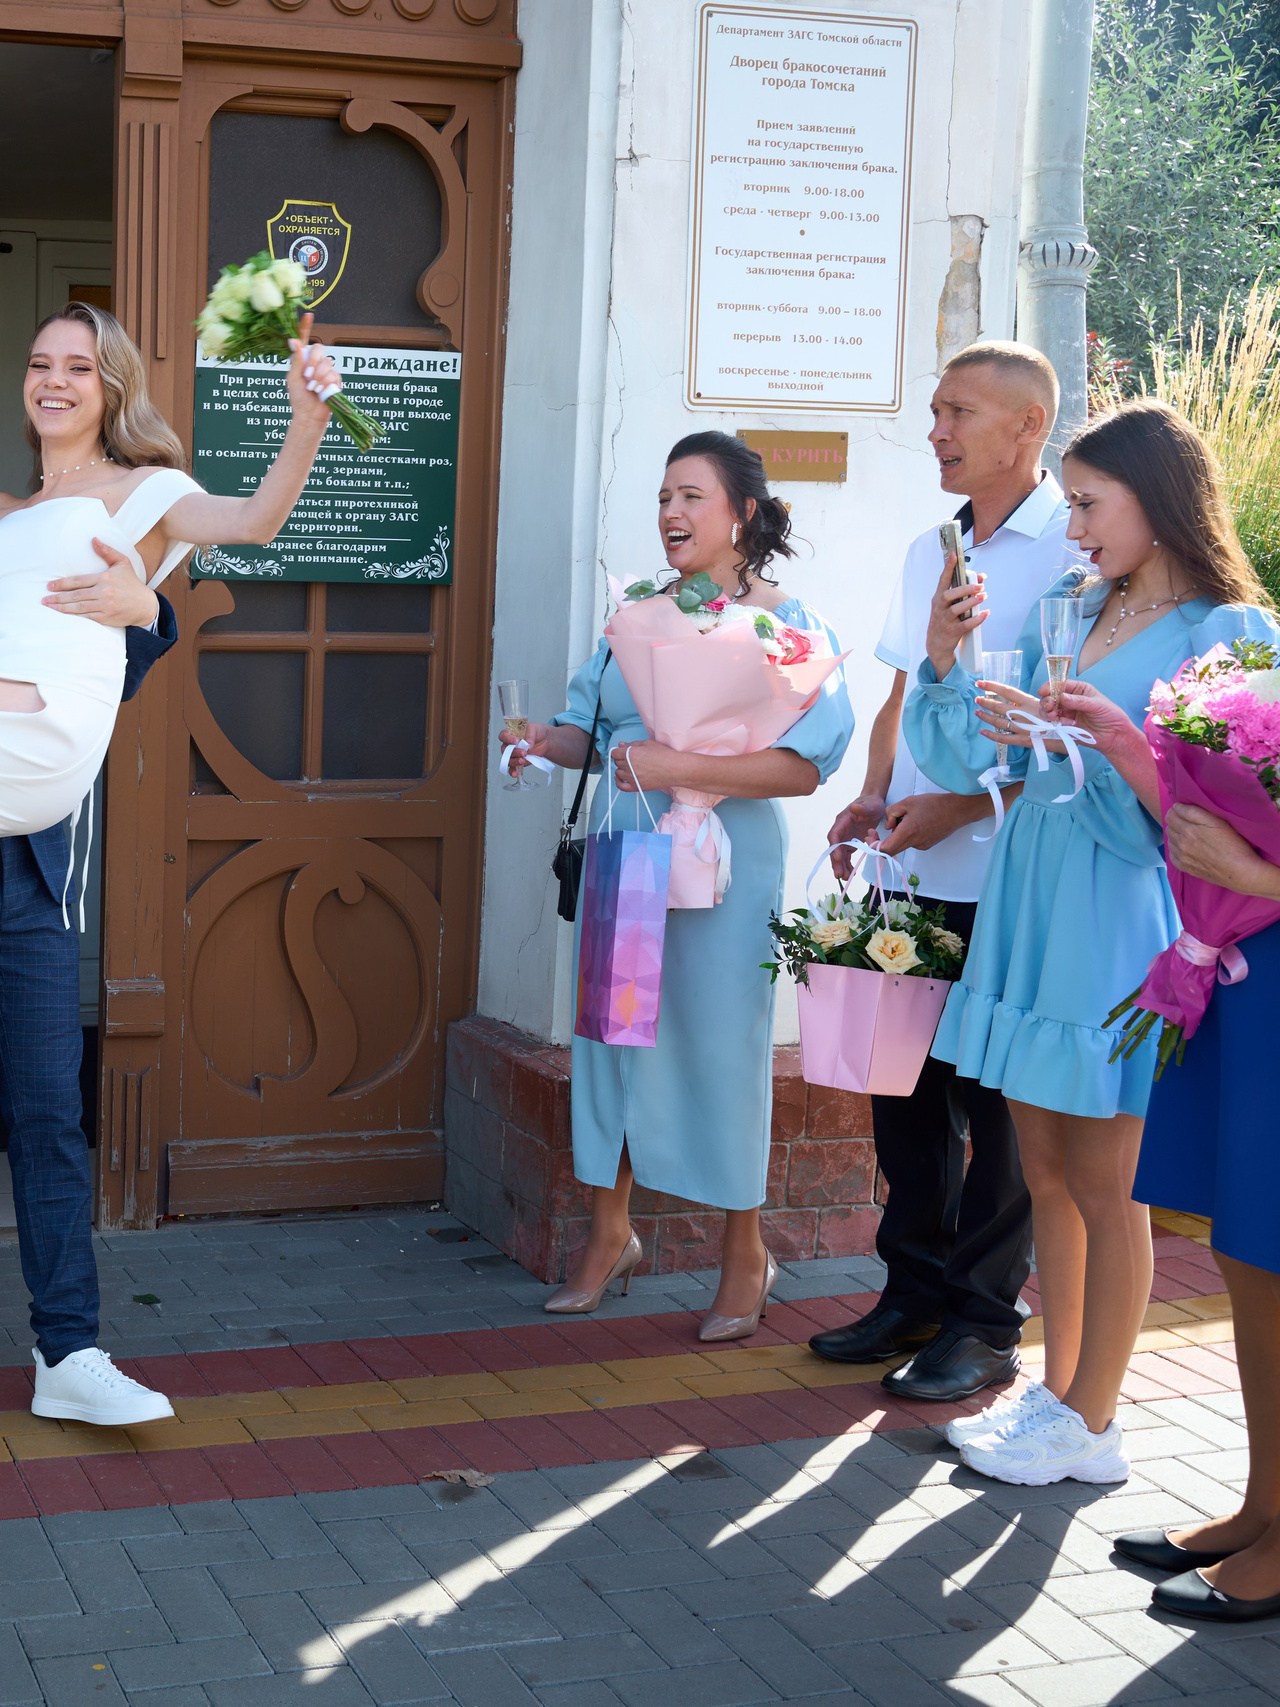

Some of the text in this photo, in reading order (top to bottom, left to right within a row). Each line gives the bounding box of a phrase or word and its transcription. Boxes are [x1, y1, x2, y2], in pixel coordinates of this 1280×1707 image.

[716, 25, 902, 47] Департамент ЗАГС Томской области
[730, 56, 887, 77] Дворец бракосочетаний
[762, 77, 855, 92] города Томска
[757, 120, 856, 135] Прием заявлений
[748, 138, 863, 154] на государственную
[711, 155, 898, 174] регистрацию заключения брака.
[744, 183, 864, 198] вторник 9.00-18.00
[290, 215, 328, 224] ОБЪЕКТ
[723, 206, 756, 215] среда
[768, 209, 812, 220] четверг
[820, 211, 880, 222] 9.00-13.00
[279, 225, 340, 235] ОХРАНЯЕТСЯ
[715, 246, 886, 265] Государственная регистрация
[746, 267, 855, 280] заключения брака:
[818, 306, 841, 315] 9.00
[854, 308, 882, 317] 18.00
[733, 333, 781, 343] перерыв
[793, 335, 822, 343] 13.00
[834, 336, 862, 345] 14.00
[343, 356, 457, 374] граждане!
[719, 367, 789, 377] воскресенье
[800, 370, 872, 380] понедельник
[220, 374, 243, 386] При
[341, 382, 399, 391] ключения
[403, 382, 437, 394] брака
[768, 382, 824, 390] выходной
[224, 391, 258, 399] целях
[403, 398, 443, 408] городе
[232, 402, 292, 413] избежани
[383, 410, 404, 419] при
[408, 411, 451, 421] выходе
[380, 422, 409, 431] ЗАГС
[216, 450, 268, 459] осыпать
[357, 455, 426, 464] лепестками
[429, 458, 452, 467] роз,
[772, 448, 843, 464] КУРИТЬ
[333, 467, 386, 476] зернами,
[326, 476, 370, 487] бокалы
[384, 481, 409, 489] т.п.;
[335, 501, 418, 509] пиротехникой
[345, 514, 386, 522] органу
[389, 513, 418, 521] ЗАГС
[288, 523, 362, 533] территории.
[316, 541, 386, 553] благодарим
